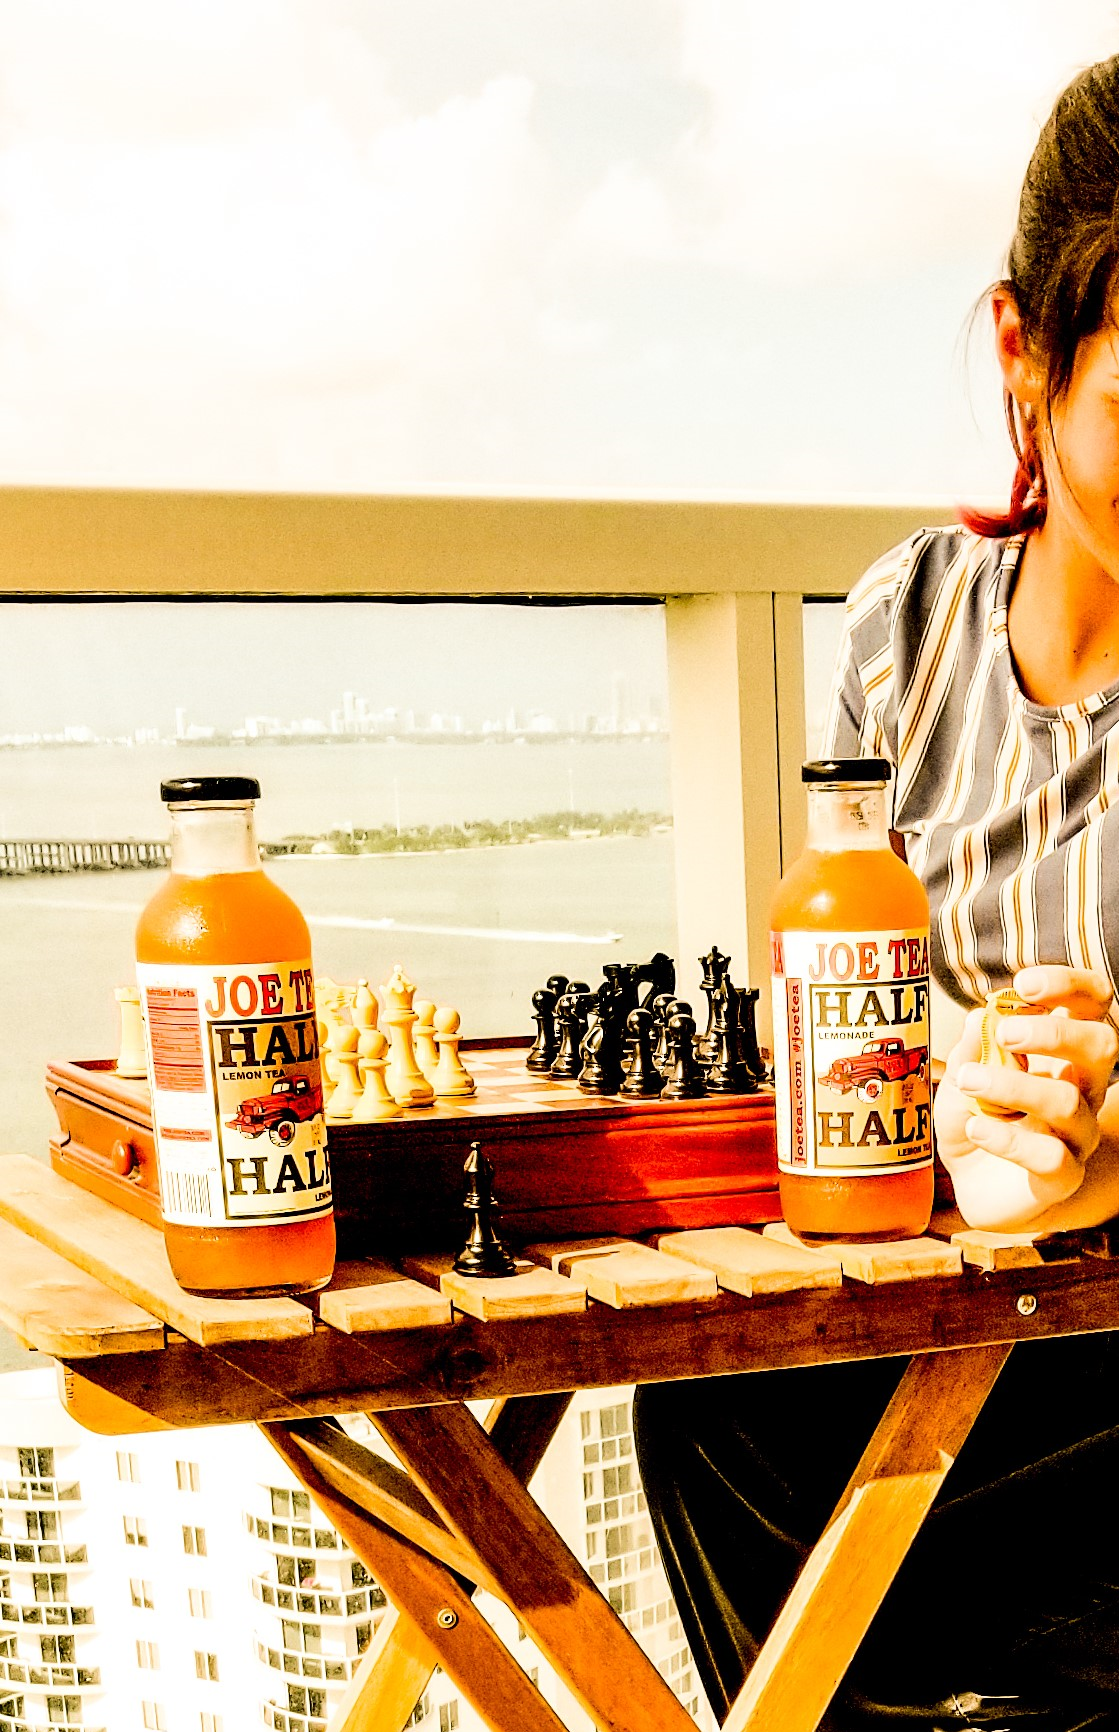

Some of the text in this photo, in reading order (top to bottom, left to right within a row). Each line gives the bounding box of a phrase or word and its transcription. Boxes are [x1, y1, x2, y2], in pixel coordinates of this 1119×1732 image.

[808, 936, 930, 982] JOE TEA
[204, 973, 284, 1019] JOE
[815, 983, 929, 1028] HALF
[818, 1031, 875, 1041] LEMONADE
[222, 1068, 286, 1081] LEMON TEA
[794, 1061, 806, 1162] joetea.com
[817, 1102, 930, 1148] HALF
